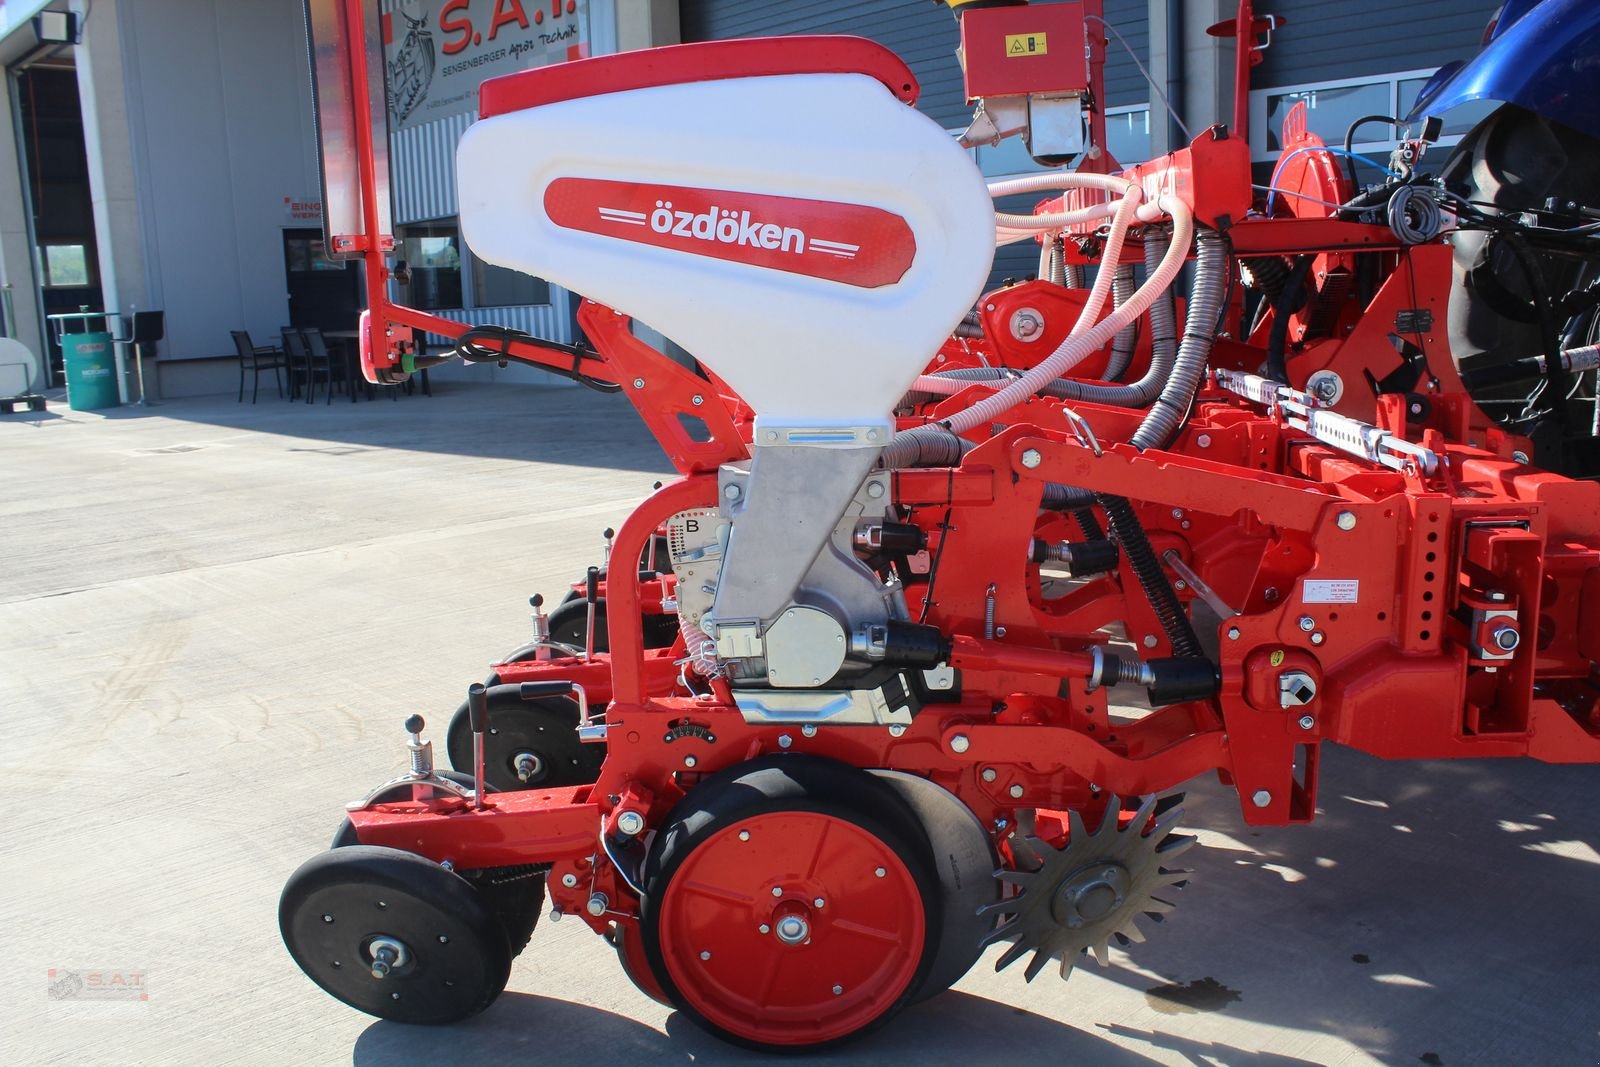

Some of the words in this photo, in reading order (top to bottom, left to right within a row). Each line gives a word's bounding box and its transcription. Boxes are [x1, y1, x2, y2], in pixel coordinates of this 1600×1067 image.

[441, 48, 507, 77] SENSENBERGER
[538, 23, 578, 45] Technik
[650, 200, 805, 254] özdöken
[686, 519, 699, 533] B
